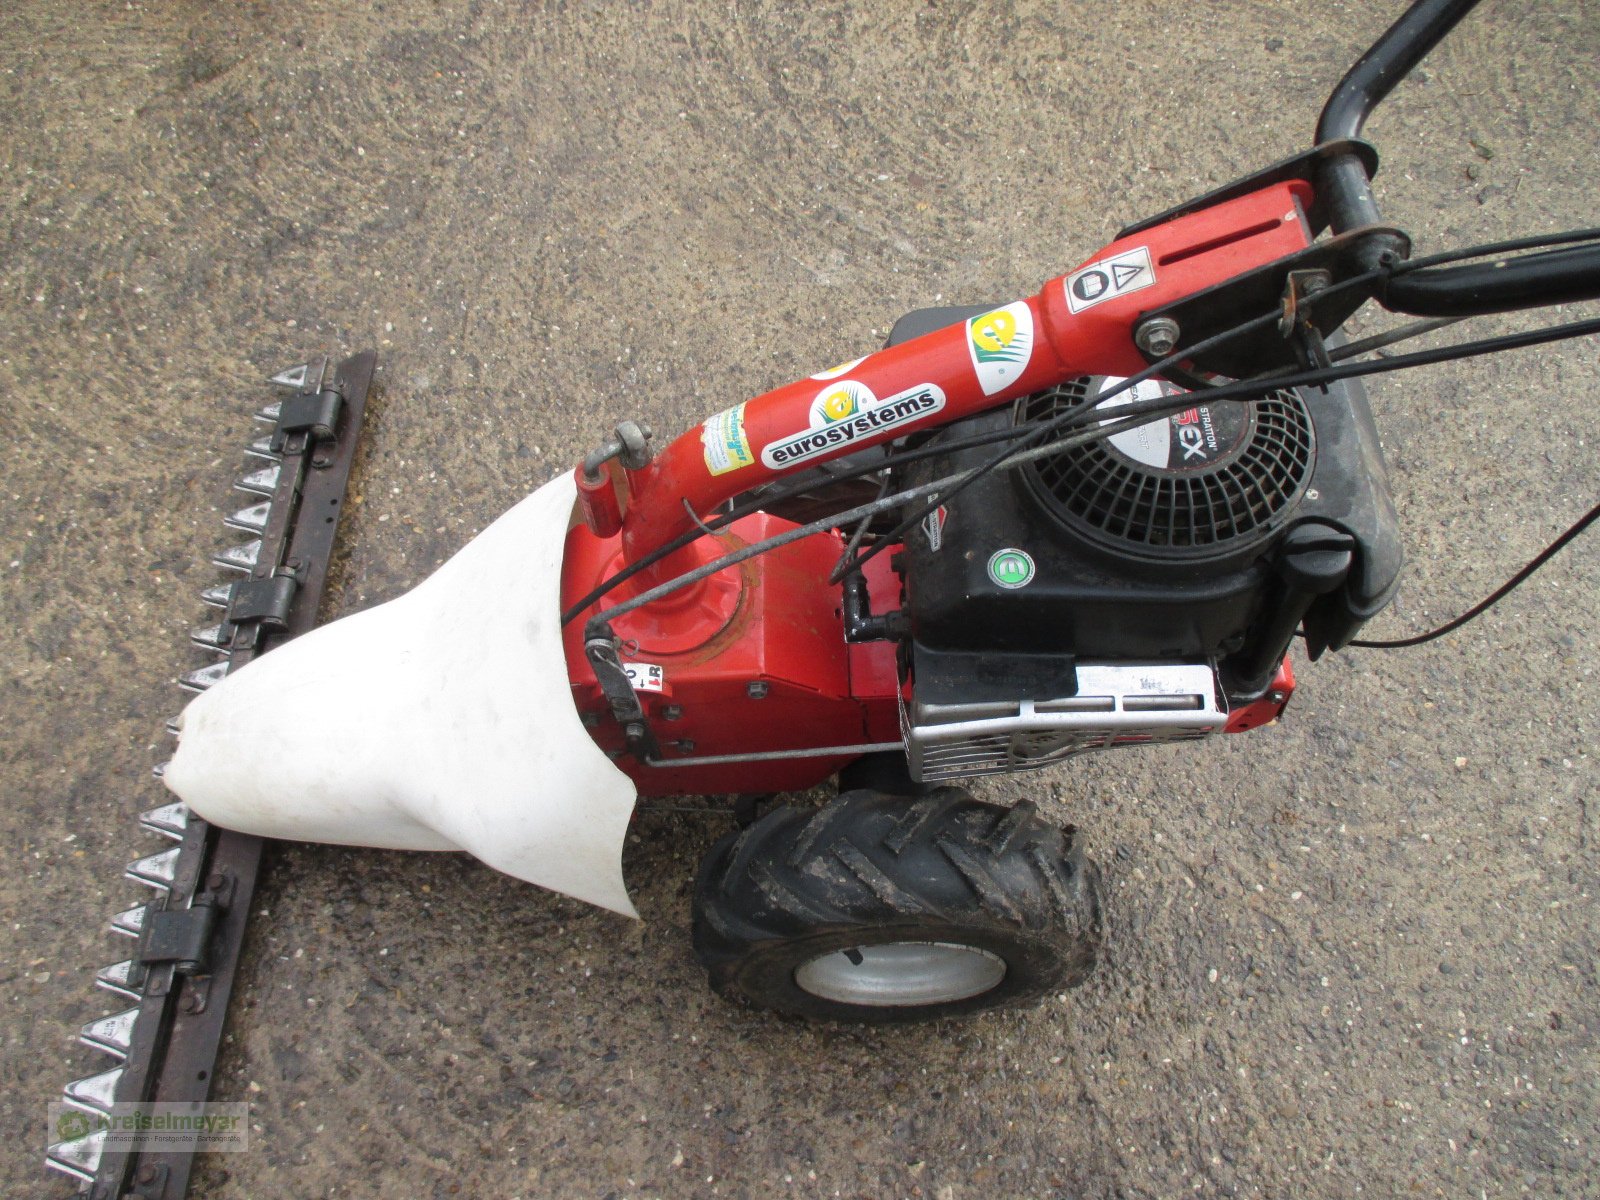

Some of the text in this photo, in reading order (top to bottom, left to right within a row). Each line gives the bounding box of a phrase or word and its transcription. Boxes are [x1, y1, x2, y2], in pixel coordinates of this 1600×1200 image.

[772, 391, 936, 463] eurosystems
[1200, 407, 1217, 451] STRATTON
[649, 666, 660, 677] R
